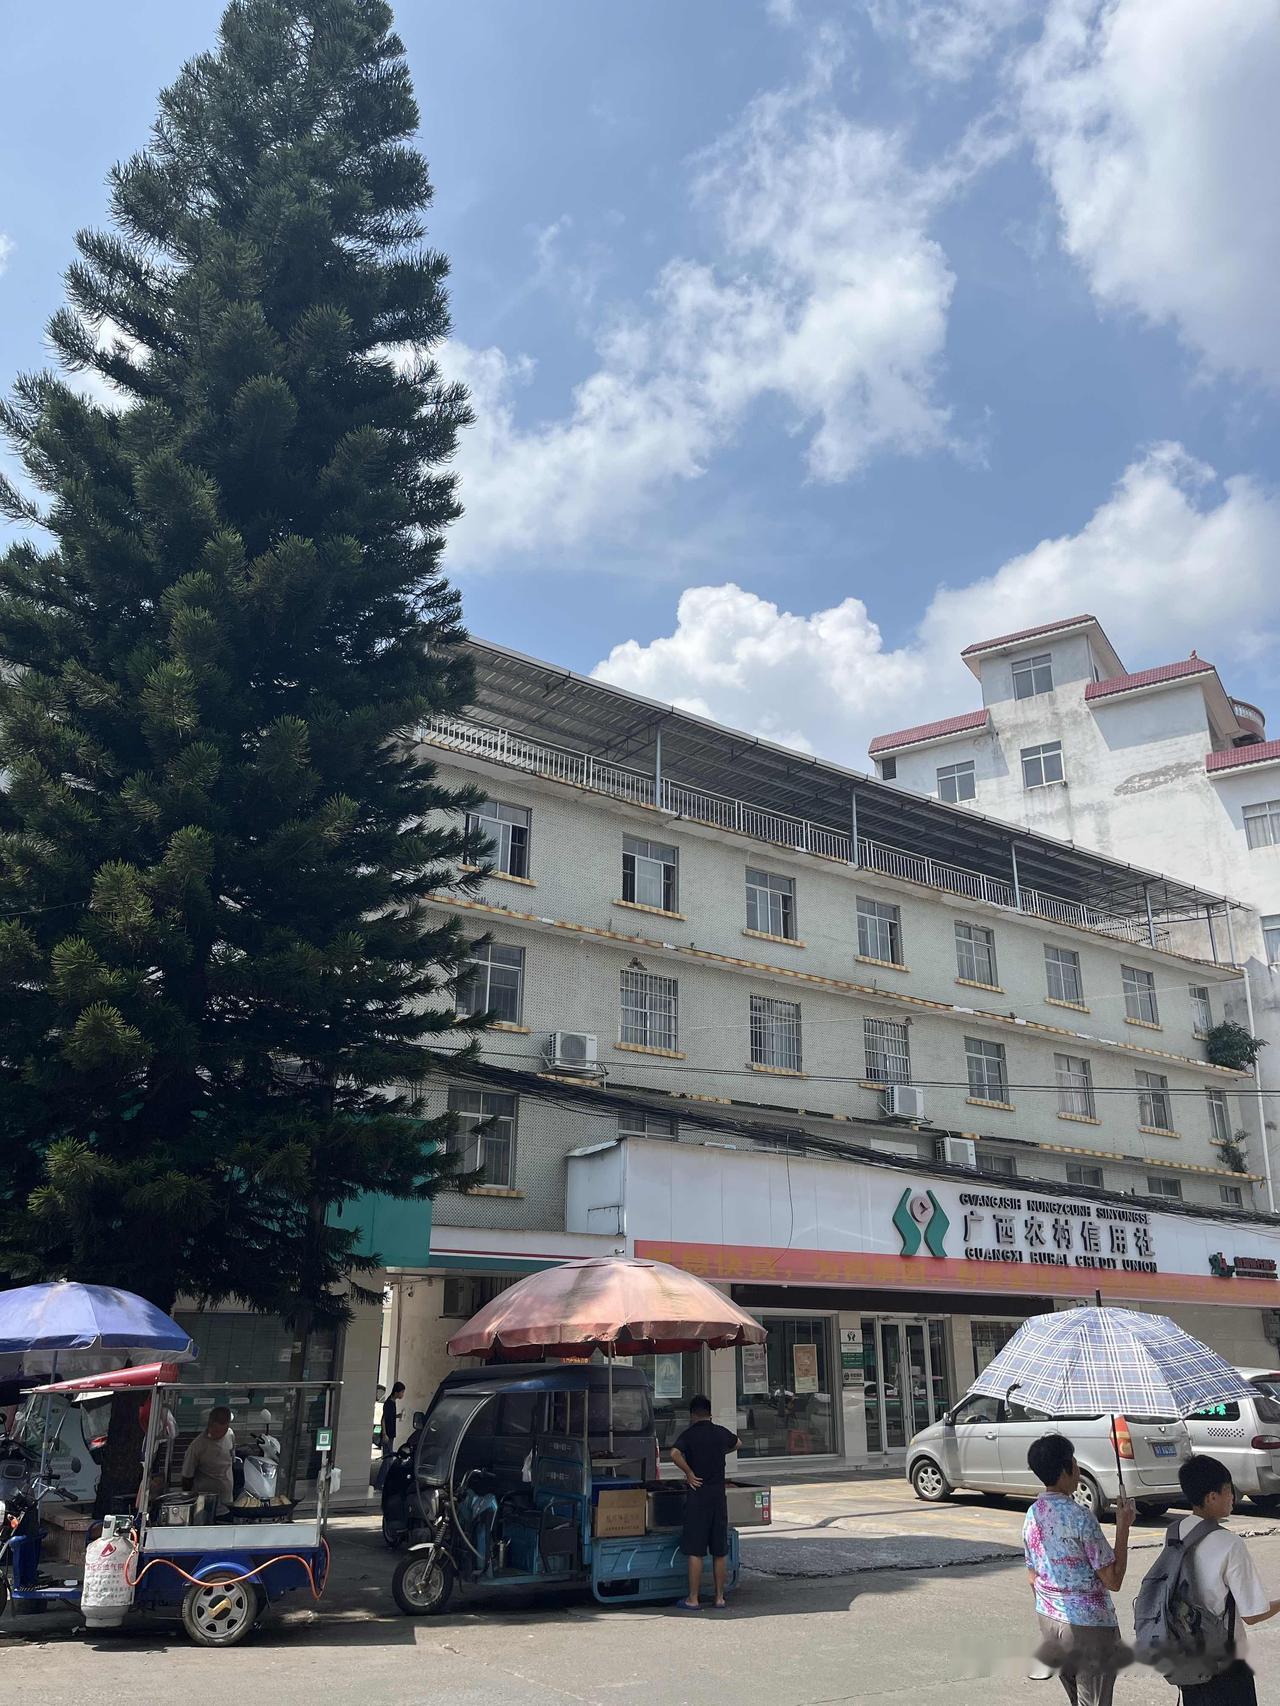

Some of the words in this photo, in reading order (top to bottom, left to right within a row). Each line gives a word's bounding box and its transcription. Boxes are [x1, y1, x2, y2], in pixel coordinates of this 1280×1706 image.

[963, 1210, 1156, 1257] 广西农村信用社
[964, 1246, 1024, 1263] GUANGXI
[1029, 1251, 1069, 1268] RURAL
[1121, 1258, 1158, 1274] UNION
